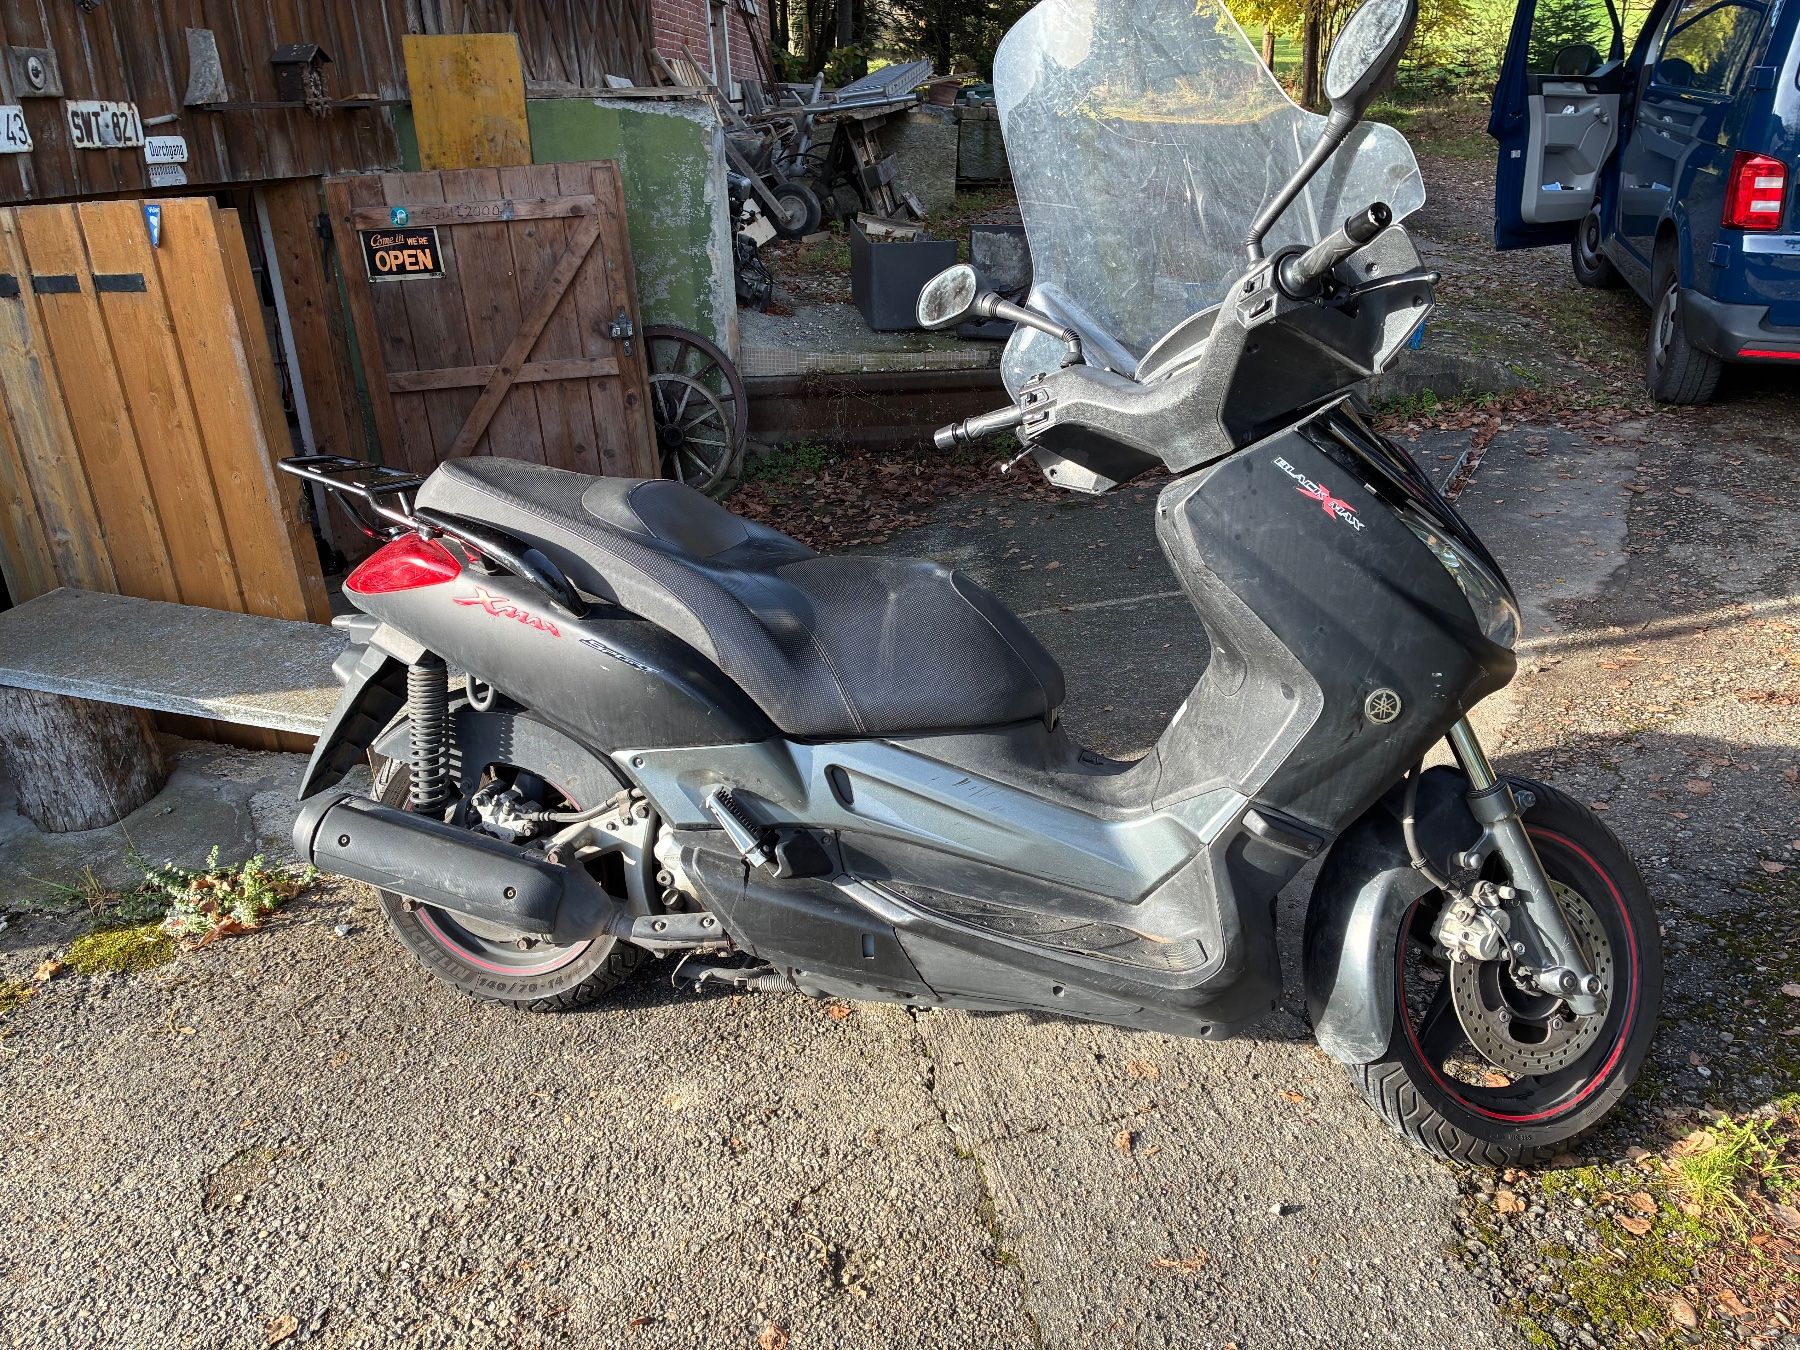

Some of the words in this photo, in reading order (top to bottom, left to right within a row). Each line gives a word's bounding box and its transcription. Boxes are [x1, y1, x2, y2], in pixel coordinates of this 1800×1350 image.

[148, 141, 184, 159] Durchgang
[465, 205, 500, 217] 2000
[370, 234, 394, 247] Come
[406, 236, 429, 246] WE'RE
[375, 248, 434, 272] OPEN
[1273, 456, 1328, 500] BLACK
[1327, 500, 1366, 531] MAX
